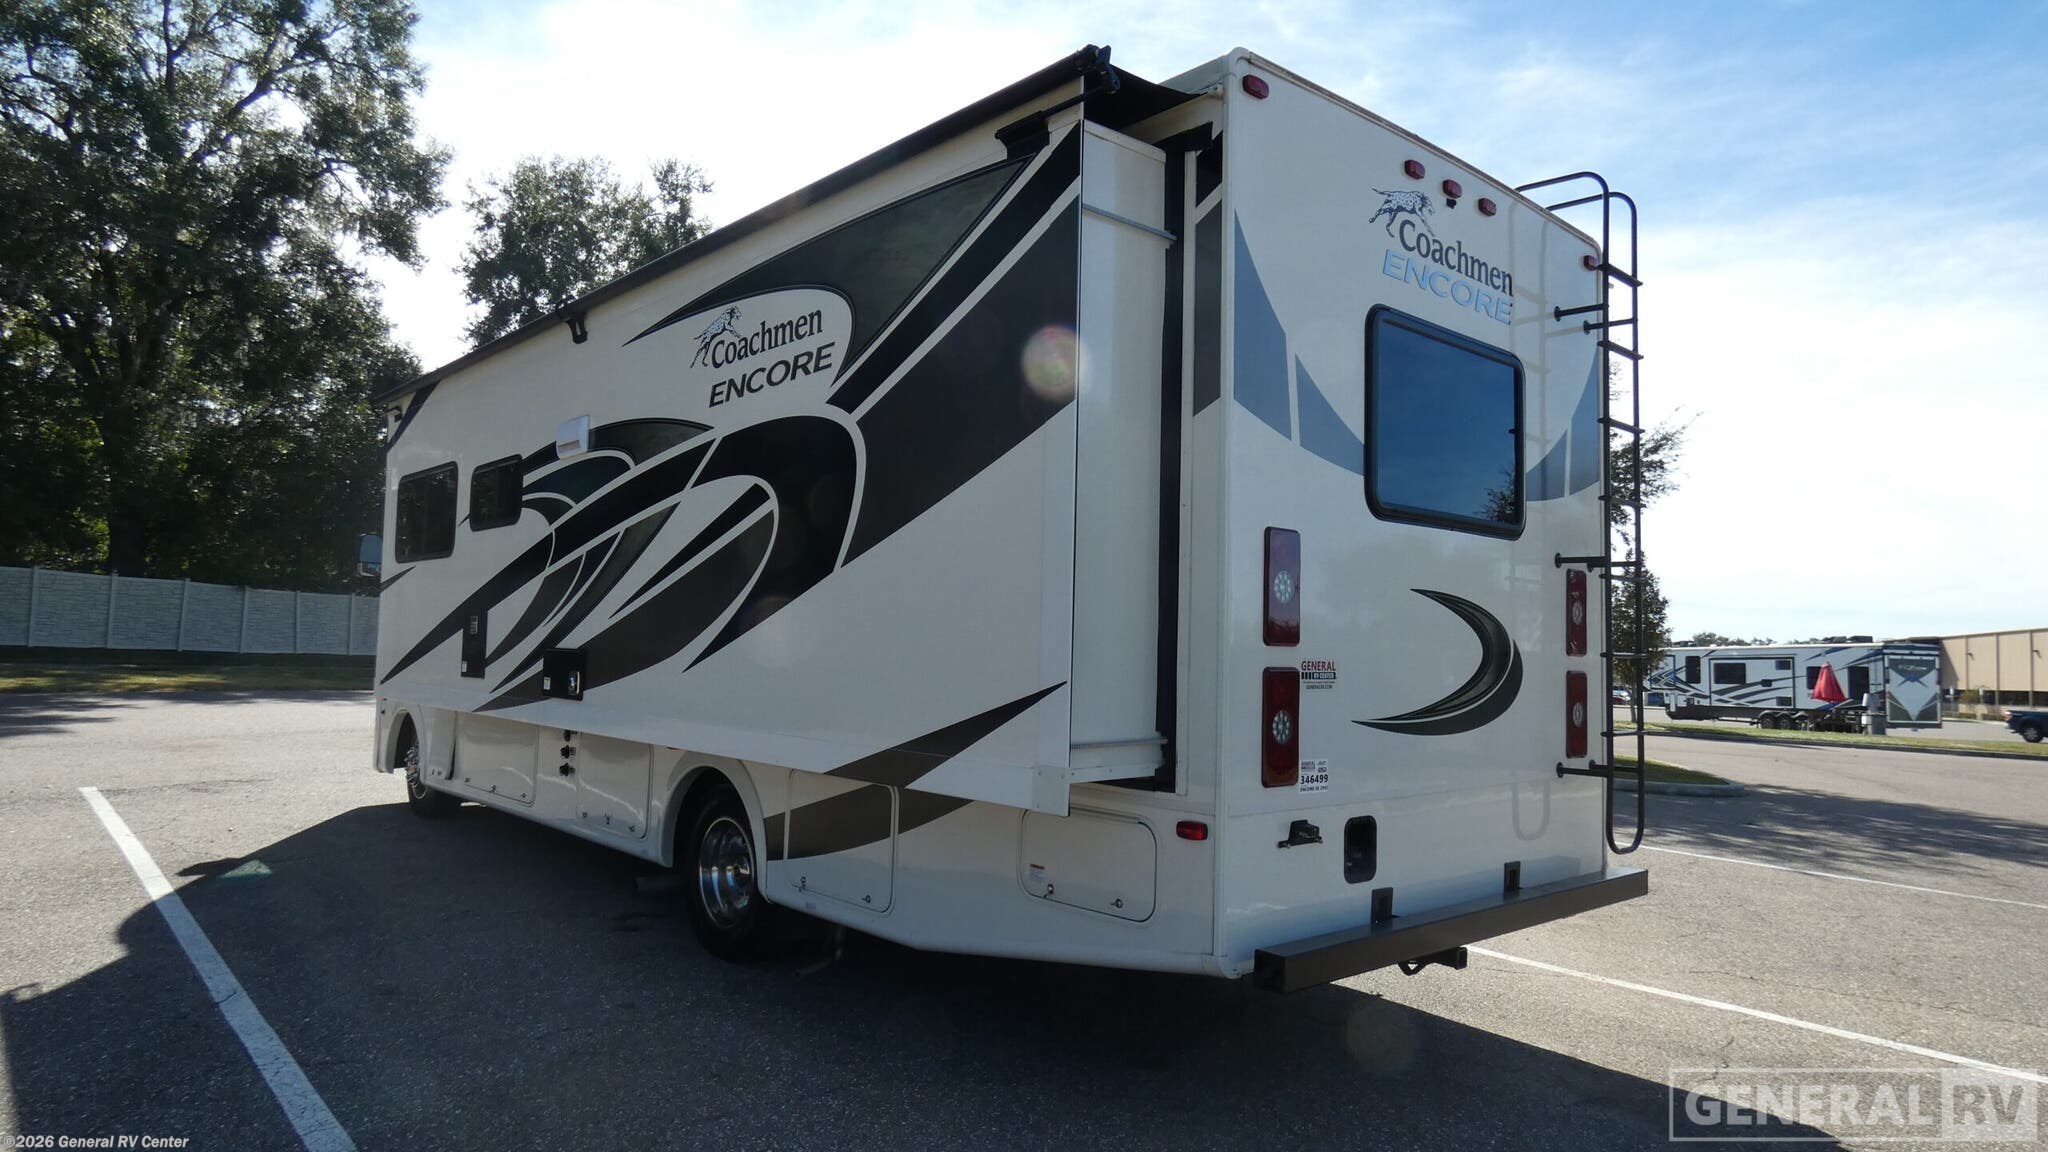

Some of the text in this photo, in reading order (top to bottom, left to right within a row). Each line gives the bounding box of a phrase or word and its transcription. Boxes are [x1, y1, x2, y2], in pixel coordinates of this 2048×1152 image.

[1382, 249, 1513, 325] ENCORE
[1399, 219, 1513, 297] Coachmen
[711, 309, 823, 369] Coachmen
[709, 341, 836, 408] ENCORE
[1301, 660, 1336, 671] GENERAL
[1300, 774, 1329, 785] 346499
